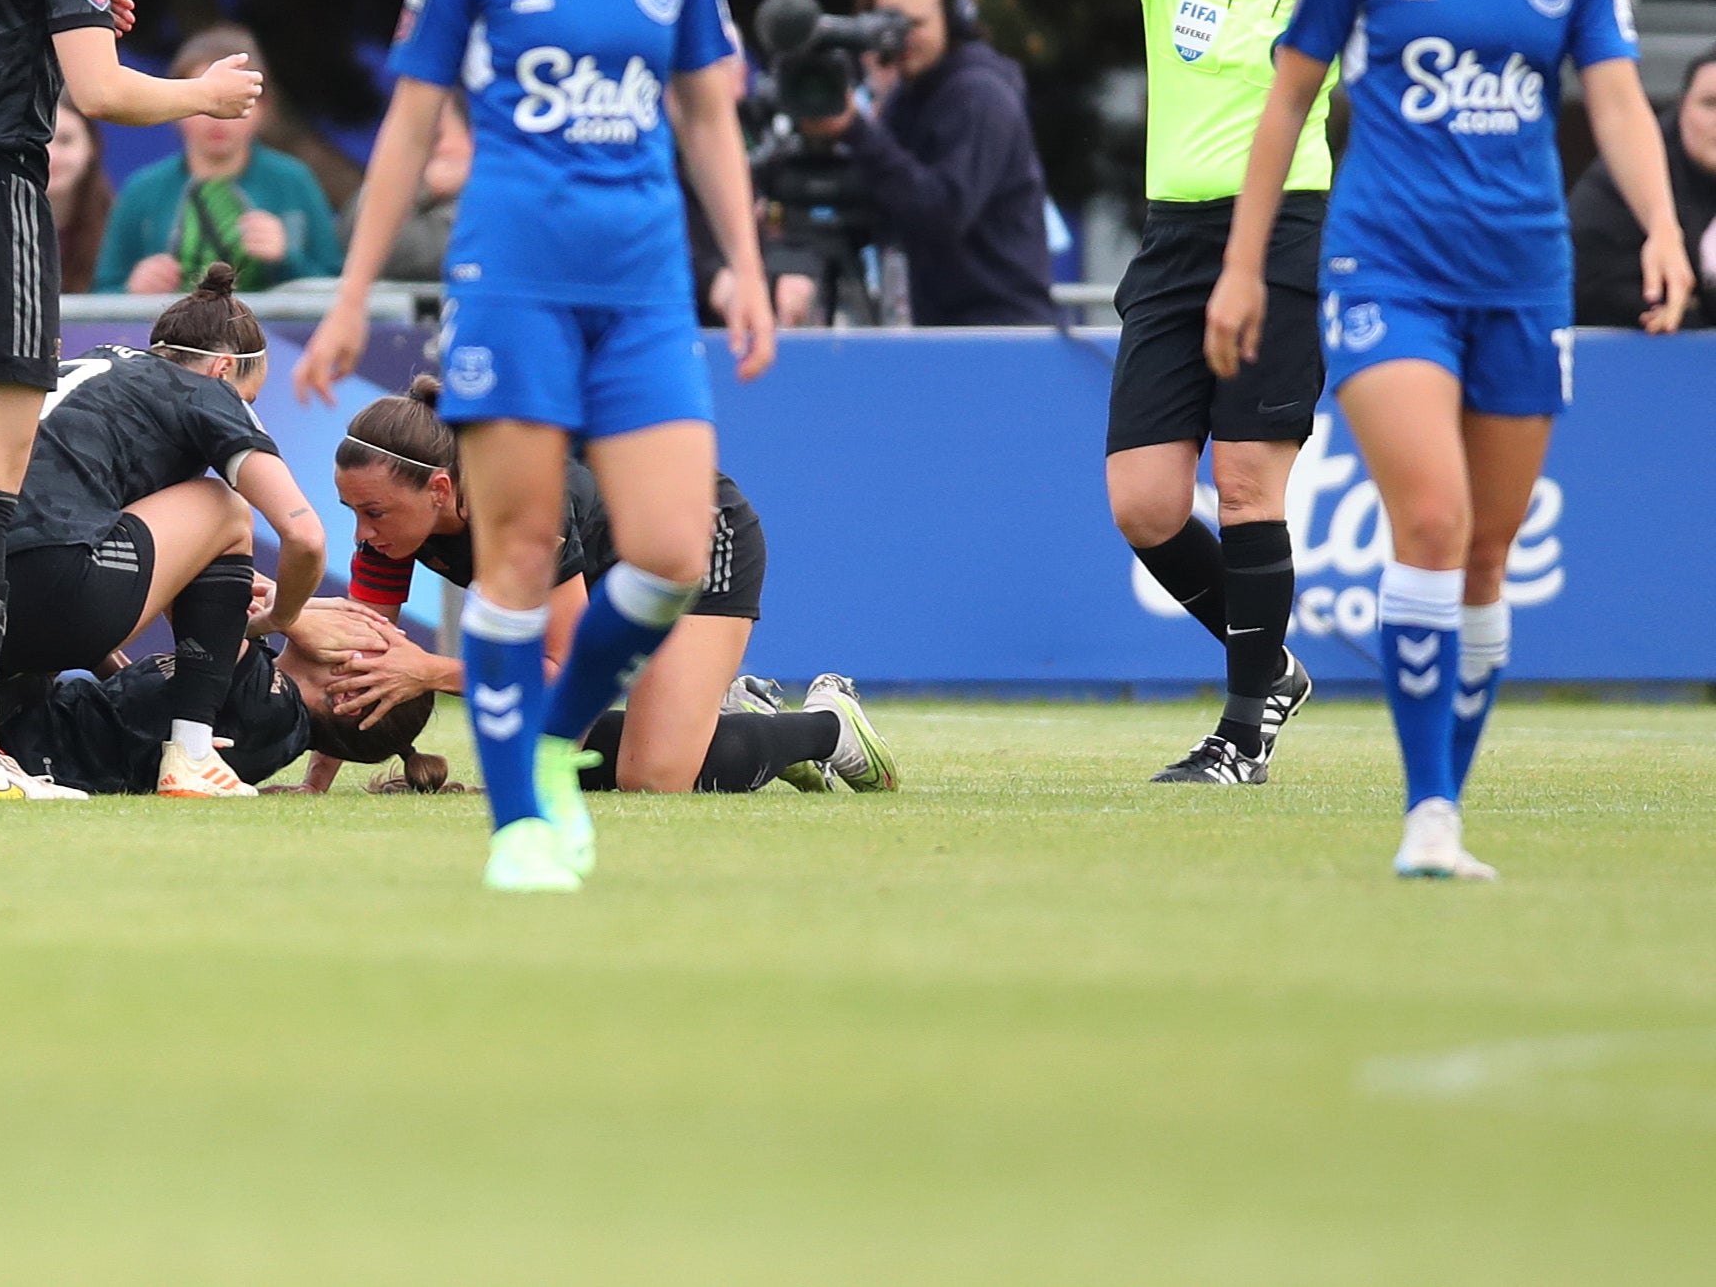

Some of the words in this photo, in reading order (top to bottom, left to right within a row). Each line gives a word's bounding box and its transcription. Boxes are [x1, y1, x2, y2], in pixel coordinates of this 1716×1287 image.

[1180, 0, 1217, 25] FIFA
[1174, 24, 1213, 43] REFEREE
[512, 45, 663, 135] Stake
[1400, 35, 1545, 125] Stake
[1447, 109, 1521, 137] .com
